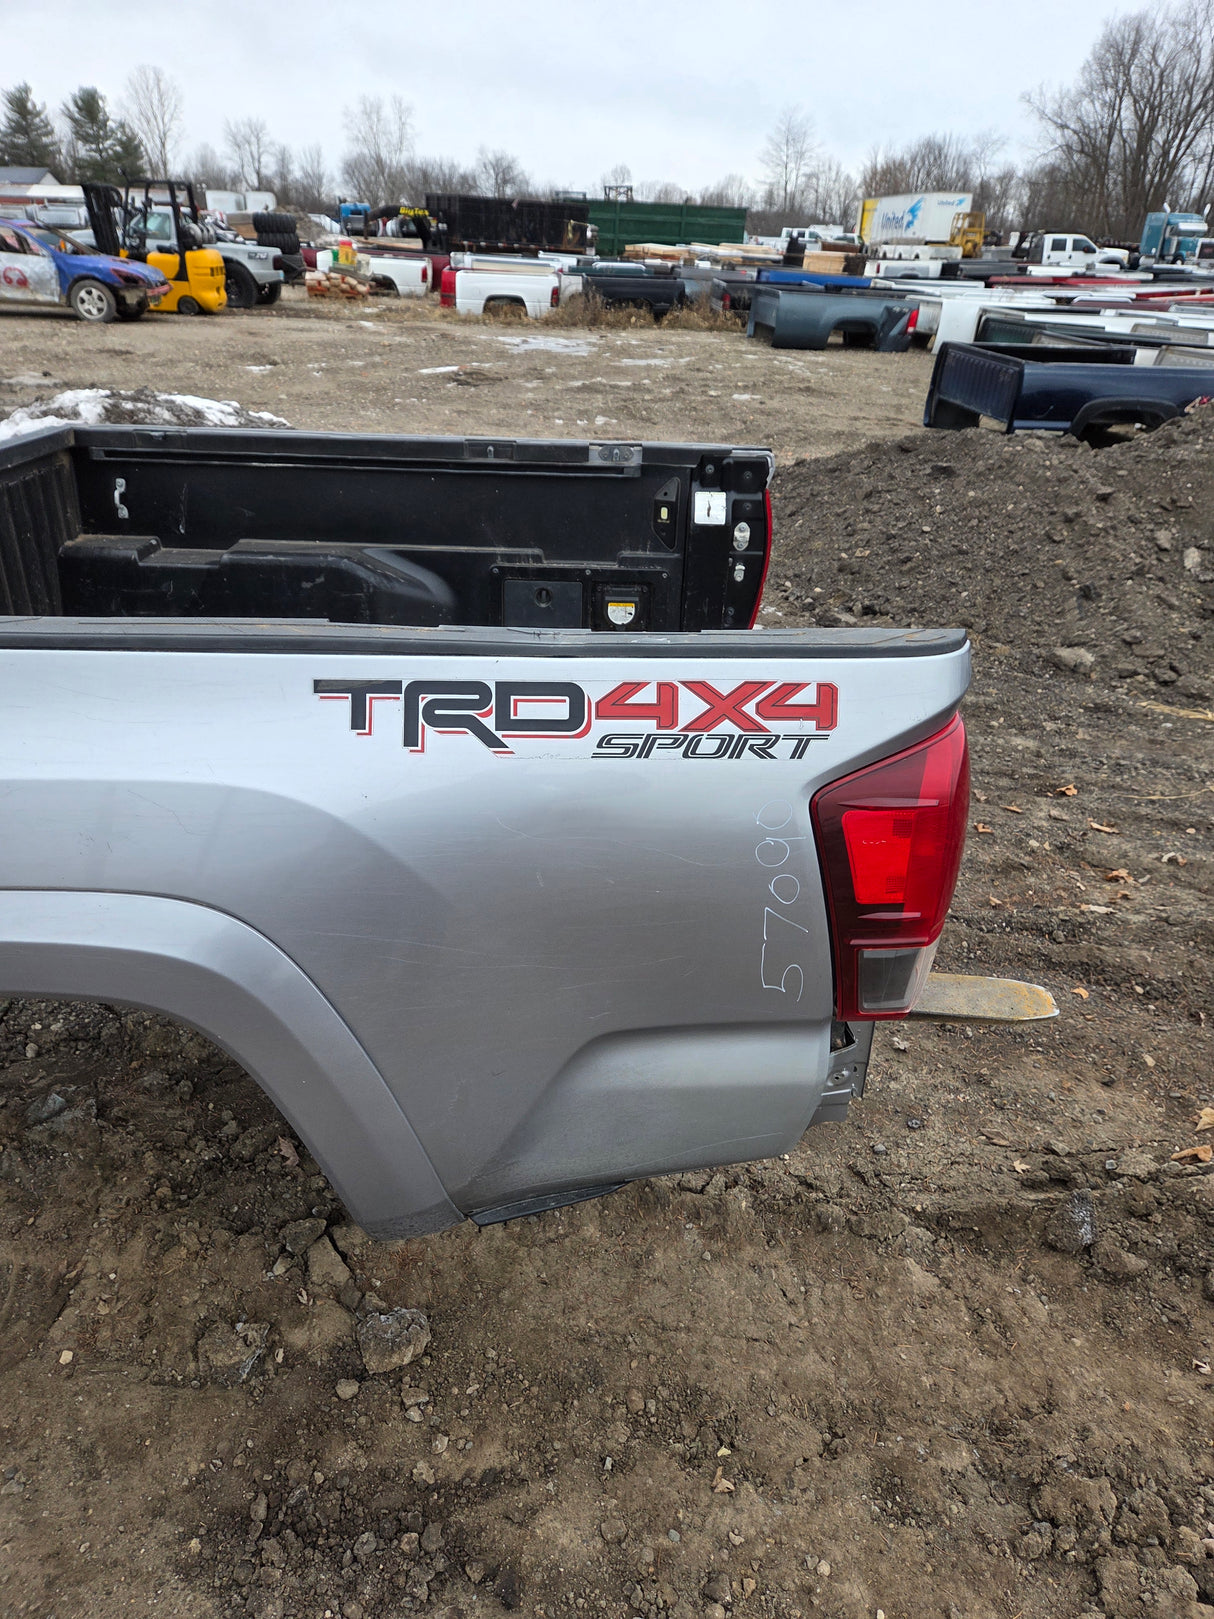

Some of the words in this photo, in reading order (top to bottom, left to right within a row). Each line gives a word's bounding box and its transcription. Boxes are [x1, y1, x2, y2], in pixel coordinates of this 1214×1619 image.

[881, 211, 904, 230] United
[313, 679, 593, 754] TRD
[595, 680, 839, 732] 4X4
[590, 733, 831, 760] SPORT
[753, 799, 808, 1002] 57090
